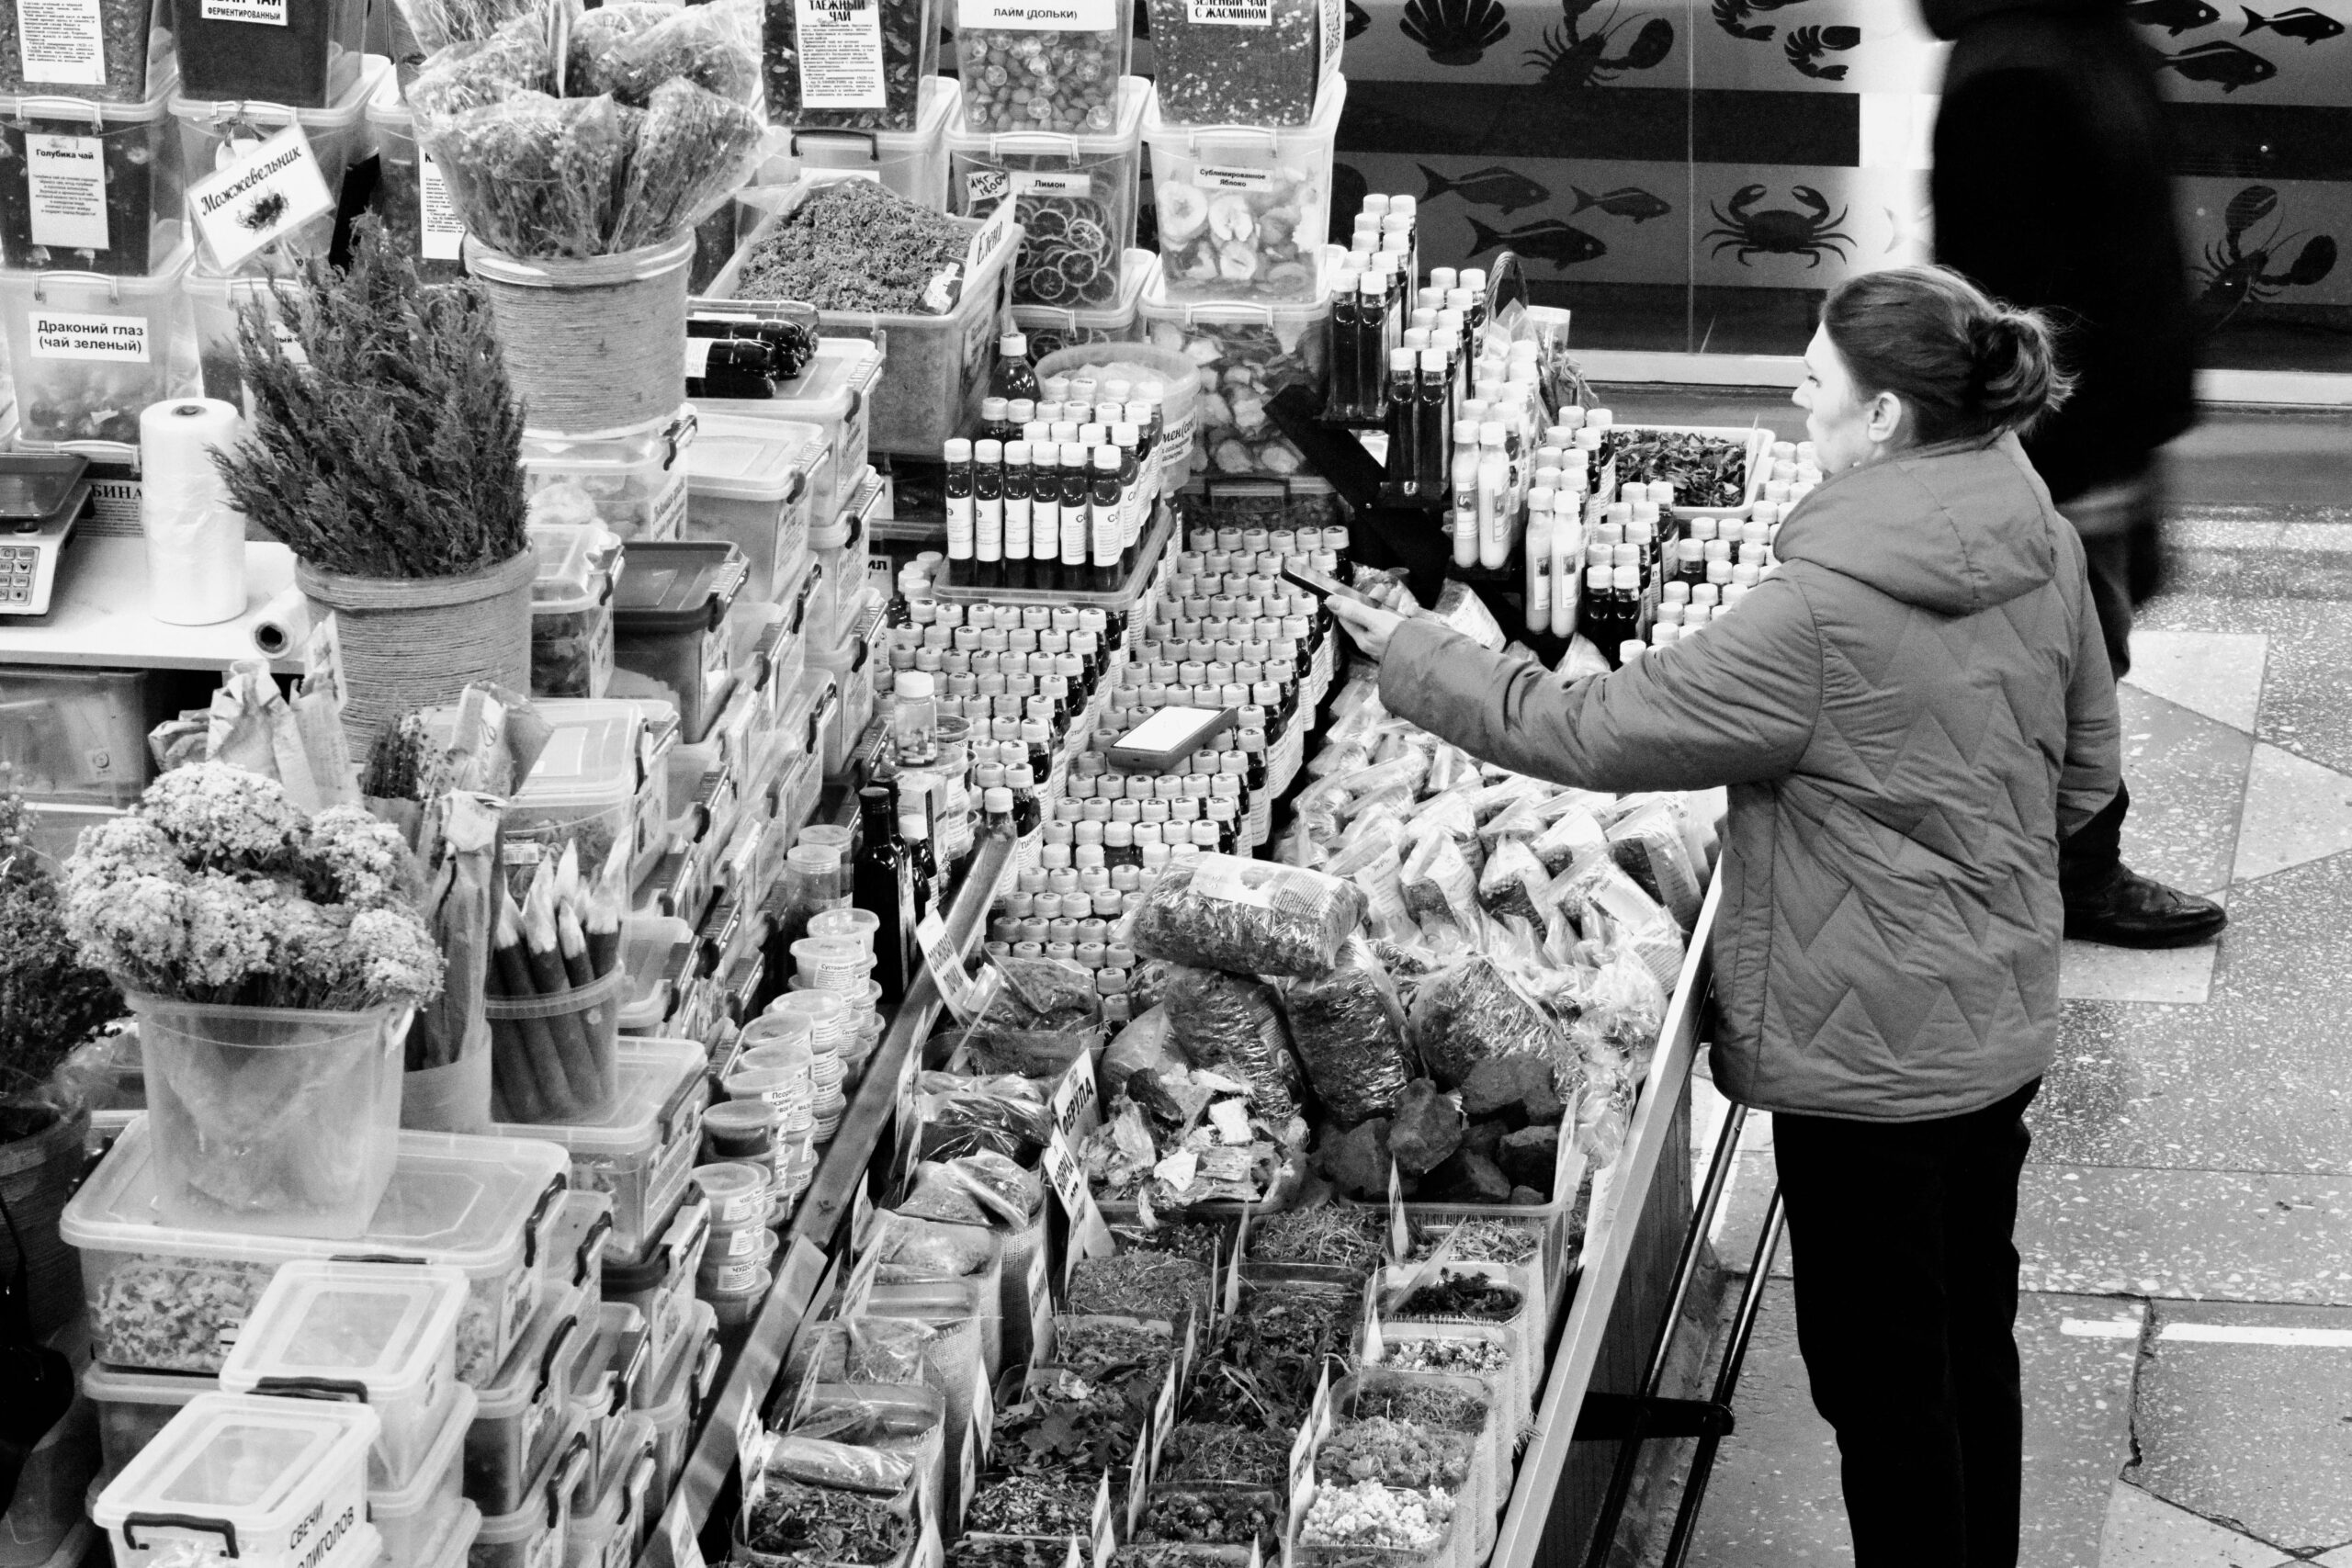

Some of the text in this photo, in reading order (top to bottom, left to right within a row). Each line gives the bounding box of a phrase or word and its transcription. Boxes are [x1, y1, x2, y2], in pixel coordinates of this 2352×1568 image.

[208, 7, 281, 20] ФЕРМЕНТИРОВАННЫЙ
[993, 7, 1078, 20] ЛАЙМ (ДОЛЬКИ)
[1194, 7, 1267, 19] С ЖАСМИНОМ
[36, 149, 94, 160] Голубика чай
[200, 144, 302, 217] Можжевельник
[1199, 168, 1266, 180] Сублимированное
[1034, 179, 1066, 188] Лимон
[1219, 178, 1247, 187] Яблоко
[38, 320, 143, 336] Драконий глаз
[39, 336, 142, 354] (чай зеленый)
[1062, 1076, 1094, 1136] ФЕРУЛА
[1054, 1151, 1075, 1197] БОЯРКА
[289, 1499, 324, 1551] СВЕЧИ
